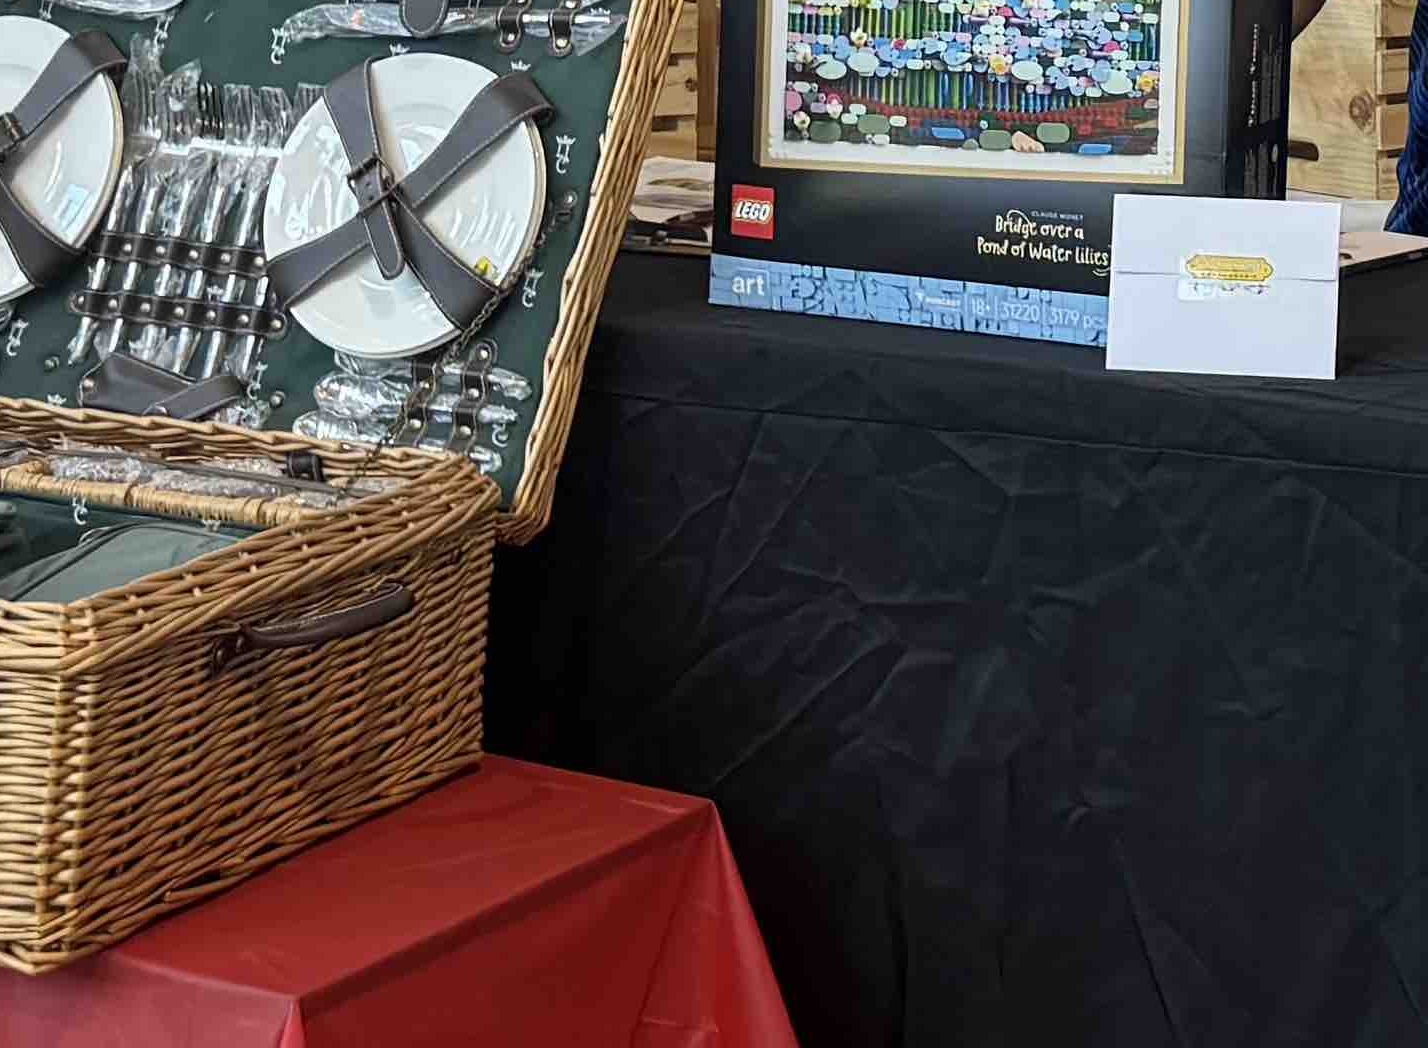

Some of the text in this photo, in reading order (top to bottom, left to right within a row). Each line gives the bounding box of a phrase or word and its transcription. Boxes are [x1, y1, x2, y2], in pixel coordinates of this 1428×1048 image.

[734, 200, 773, 224] LEGO
[995, 210, 1085, 240] Bridge over a
[977, 236, 1009, 256] Pond
[1010, 241, 1026, 259] of
[1029, 242, 1073, 263] Water
[731, 274, 765, 296] art
[1000, 302, 1041, 323] 31220
[1050, 306, 1080, 326] 3179
